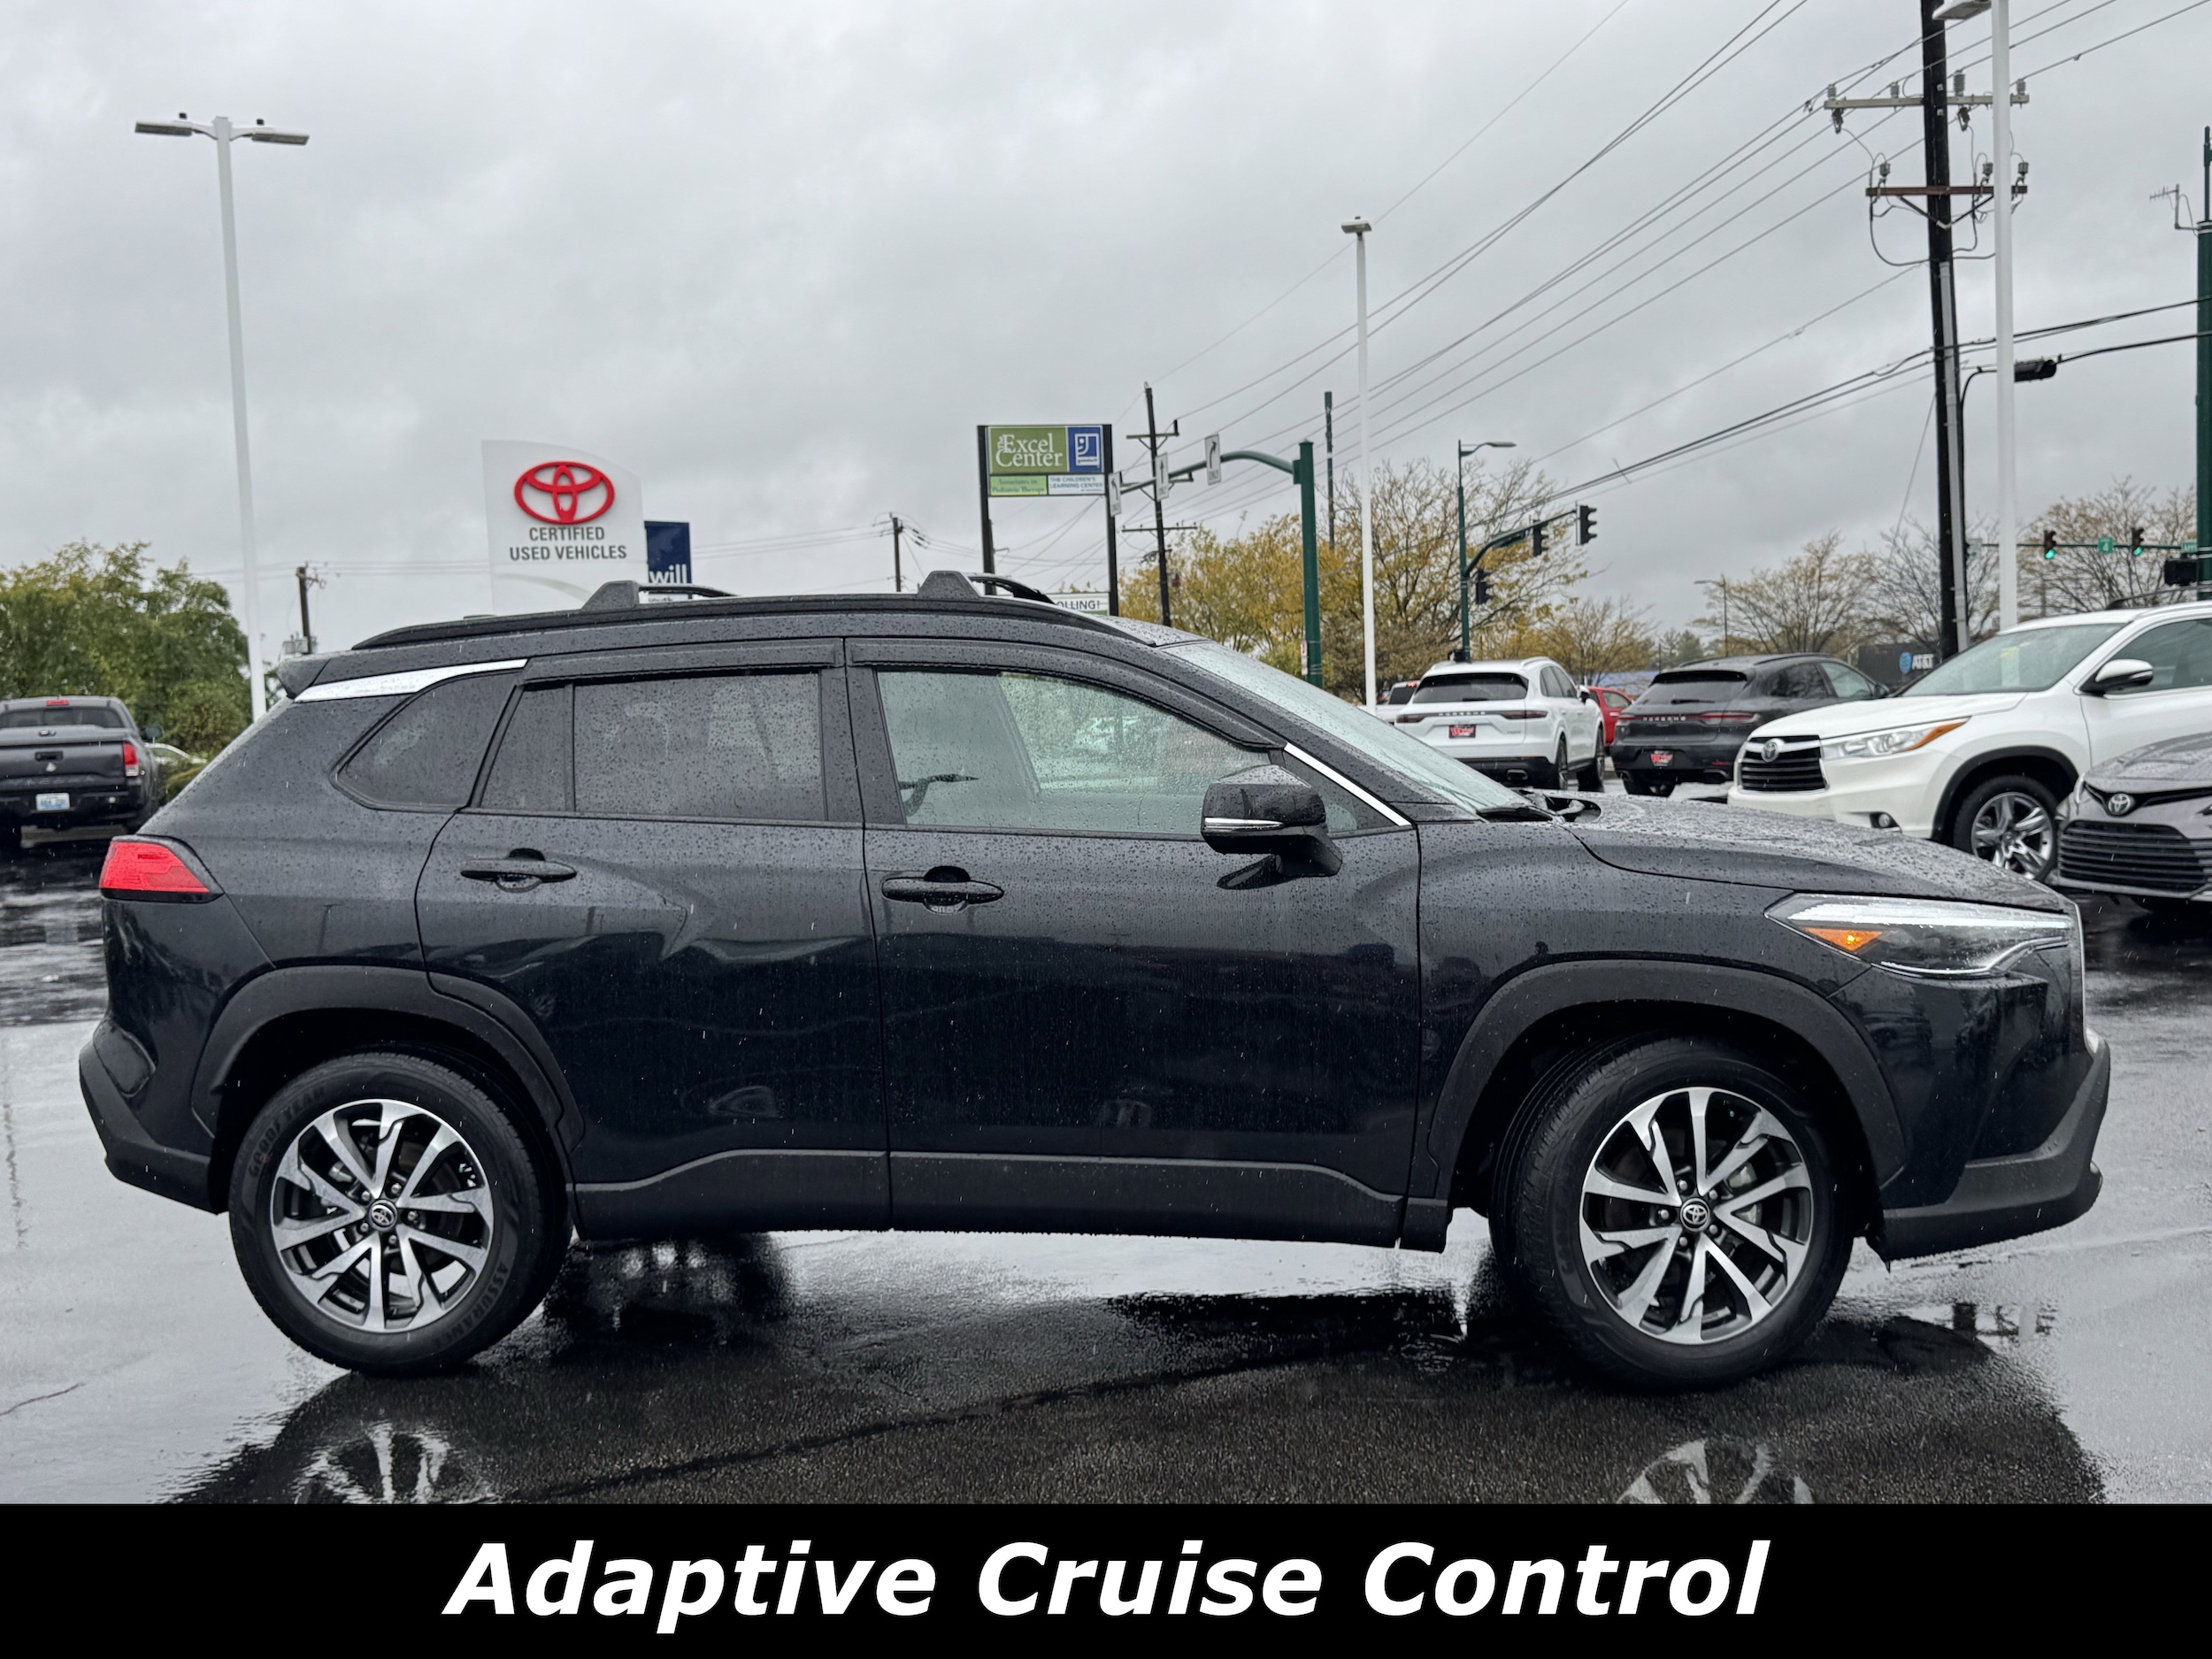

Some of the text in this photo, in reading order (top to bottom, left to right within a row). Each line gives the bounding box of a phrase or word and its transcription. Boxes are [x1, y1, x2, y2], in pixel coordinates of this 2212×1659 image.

[1002, 433, 1054, 453] Excel
[995, 449, 1064, 467] Center
[529, 526, 605, 541] CERTIFIED
[510, 545, 626, 561] USED VEHICLES
[649, 564, 687, 584] will
